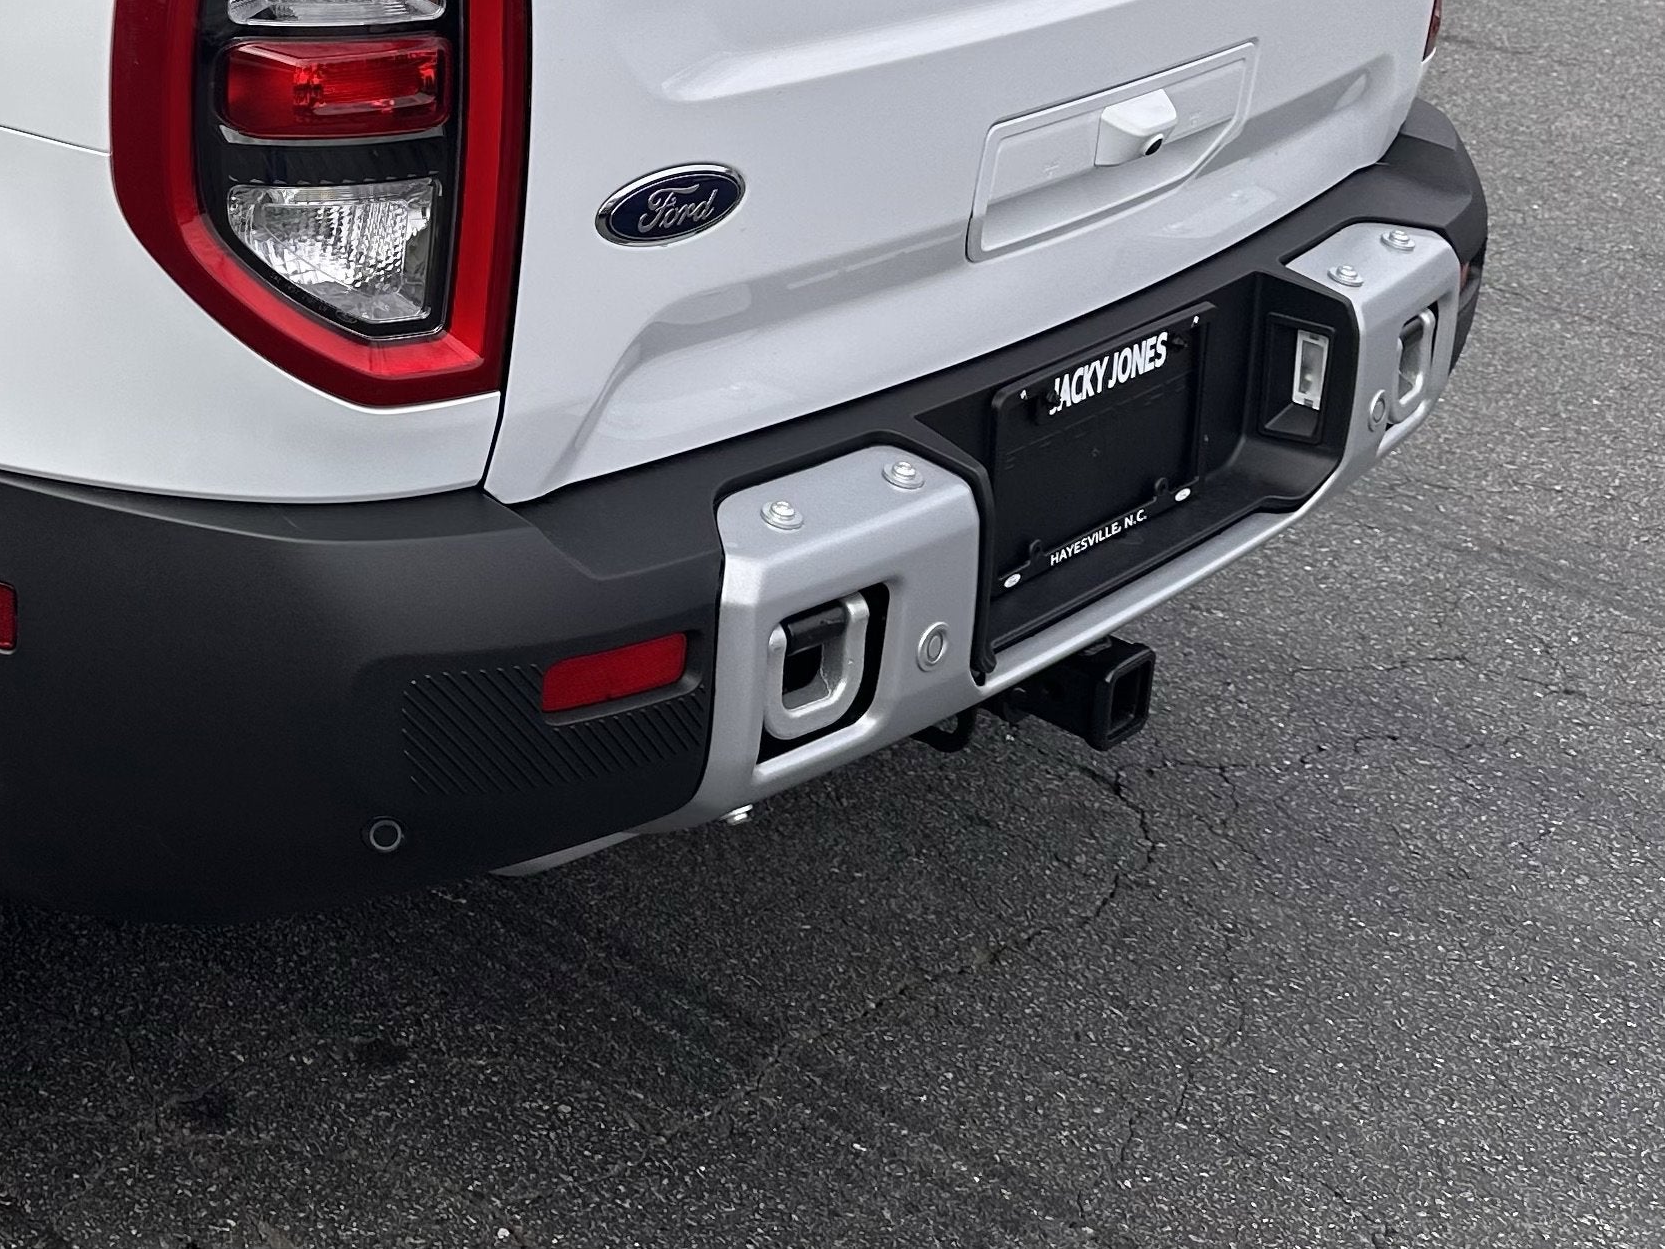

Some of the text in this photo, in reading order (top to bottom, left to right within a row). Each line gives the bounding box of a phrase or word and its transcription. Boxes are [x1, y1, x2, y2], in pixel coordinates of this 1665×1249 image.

[637, 183, 719, 233] Ford
[1049, 331, 1168, 415] JACKY JONES
[1124, 509, 1148, 529] N.C.
